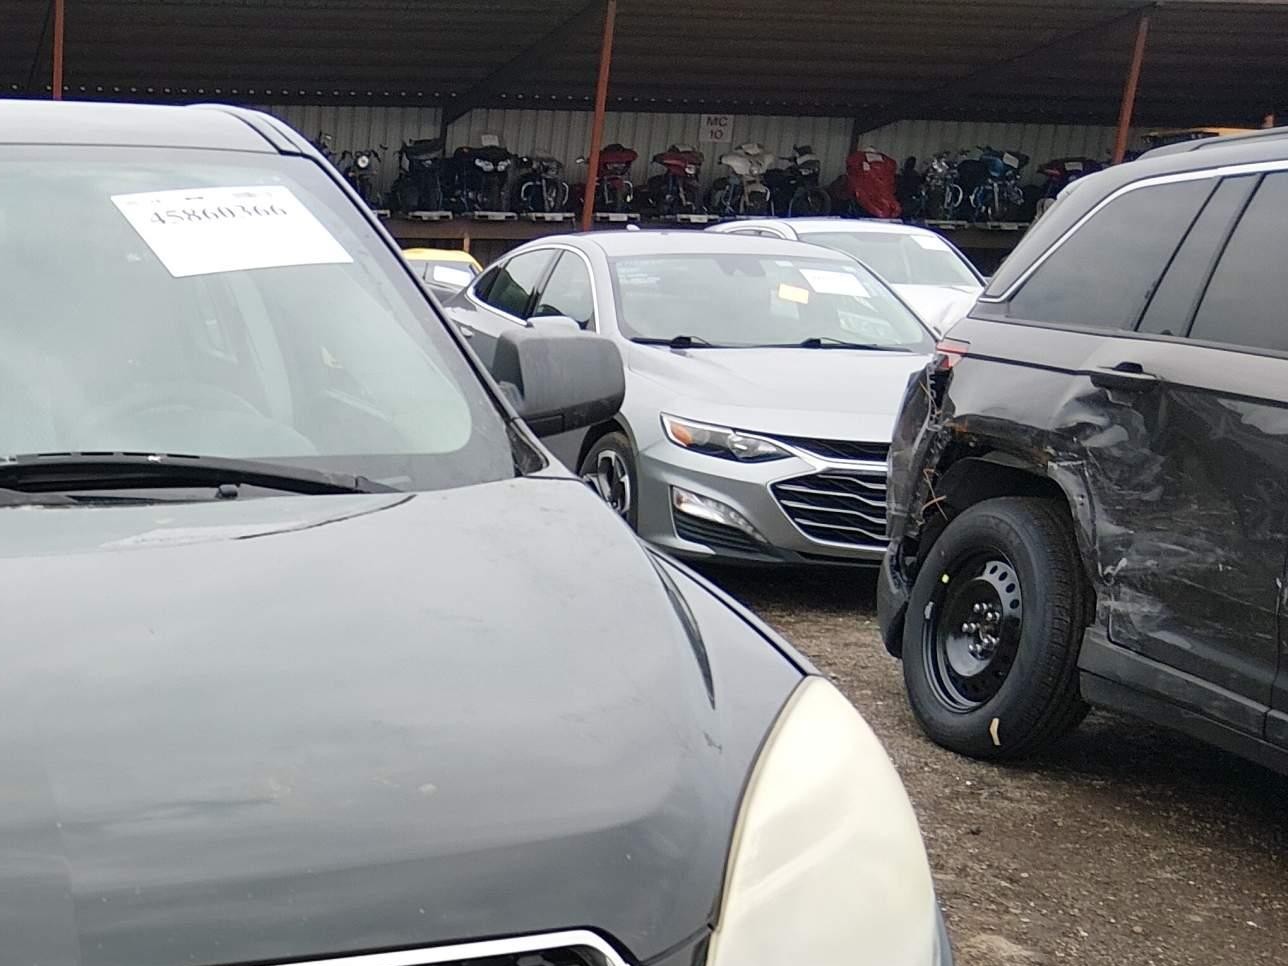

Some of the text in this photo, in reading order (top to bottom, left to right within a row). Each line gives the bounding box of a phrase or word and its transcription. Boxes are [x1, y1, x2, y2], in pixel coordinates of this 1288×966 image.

[706, 116, 729, 127] MC
[710, 129, 724, 140] 10
[150, 204, 288, 224] 45860366
